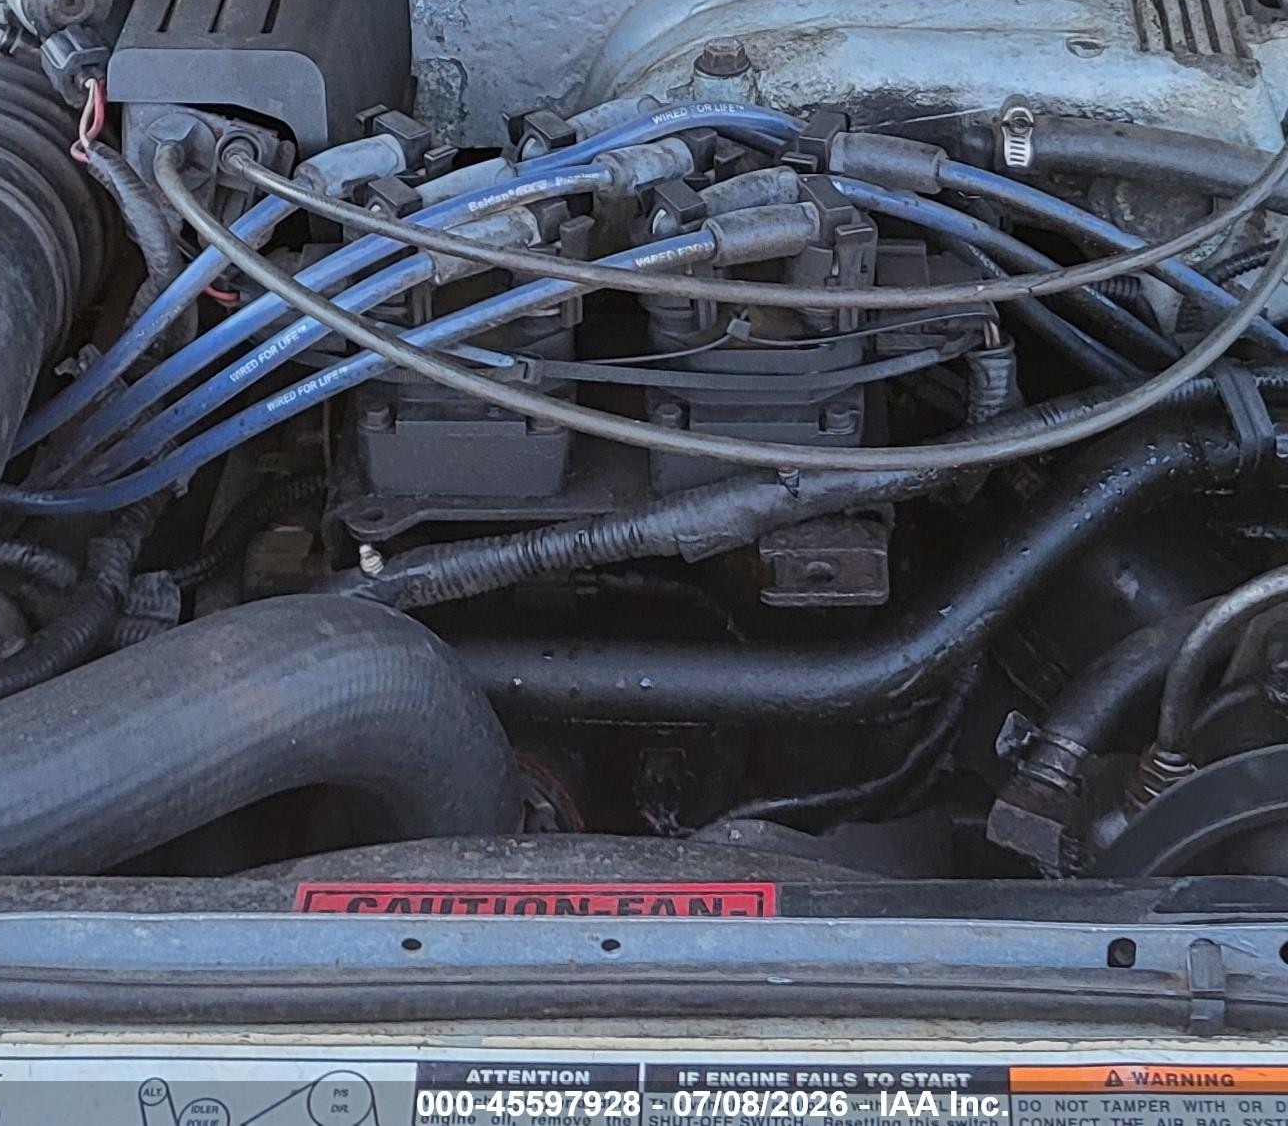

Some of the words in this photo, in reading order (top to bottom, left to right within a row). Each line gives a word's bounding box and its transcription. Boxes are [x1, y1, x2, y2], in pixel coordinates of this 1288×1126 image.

[652, 107, 688, 124] WIRED
[229, 358, 259, 383] WIRED
[258, 345, 279, 364] FOR
[266, 390, 297, 412] WIRED
[297, 380, 319, 397] FOR
[465, 1069, 591, 1086] ATTENTION
[678, 1071, 700, 1087] IF
[706, 1071, 790, 1088] ENGINE
[795, 1072, 859, 1088] FAILS
[863, 1072, 895, 1088] TO
[900, 1072, 972, 1088] START
[1131, 1071, 1236, 1087] WARNING
[190, 1104, 219, 1114] IDLER
[1018, 1099, 1043, 1113] DO
[1054, 1099, 1089, 1113] NOT
[1100, 1099, 1171, 1113] TAMPER
[1182, 1099, 1226, 1113] WITH
[1238, 1100, 1263, 1113] OR
[606, 1113, 632, 1126] the
[648, 1115, 733, 1126] SHUT-OFF
